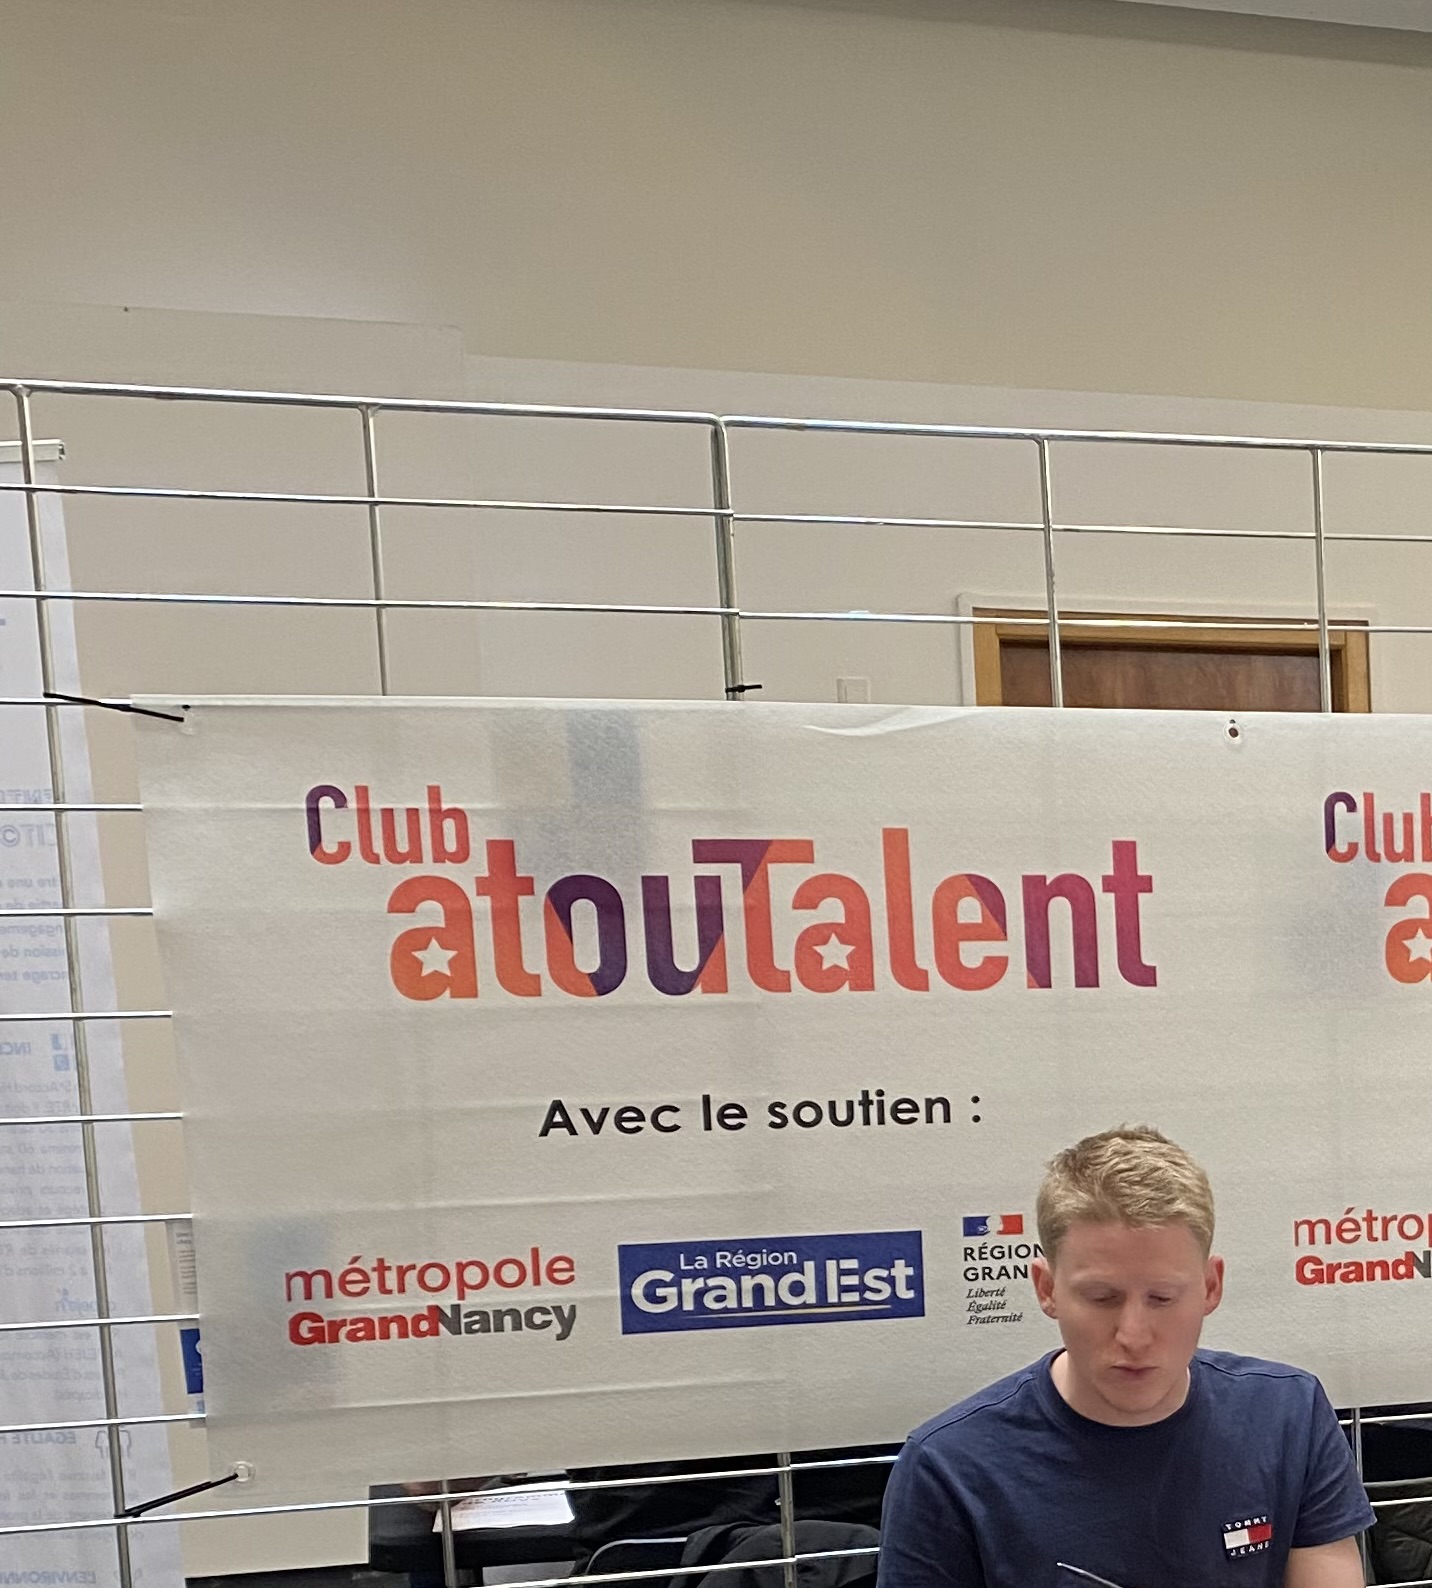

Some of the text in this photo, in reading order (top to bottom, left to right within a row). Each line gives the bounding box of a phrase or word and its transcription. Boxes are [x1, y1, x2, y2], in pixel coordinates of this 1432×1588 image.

[304, 783, 471, 866] Club
[386, 827, 1158, 1001] atouTalent
[538, 1097, 682, 1138] Avec
[701, 1093, 748, 1132] le
[767, 1089, 953, 1130] soutien
[678, 1246, 798, 1271] La Région
[283, 1246, 577, 1303] métropole
[963, 1264, 1029, 1282] GRAN
[967, 1286, 1007, 1299] Liberté
[1225, 1515, 1267, 1531] TOMMY
[1230, 1541, 1270, 1557] JEANS
